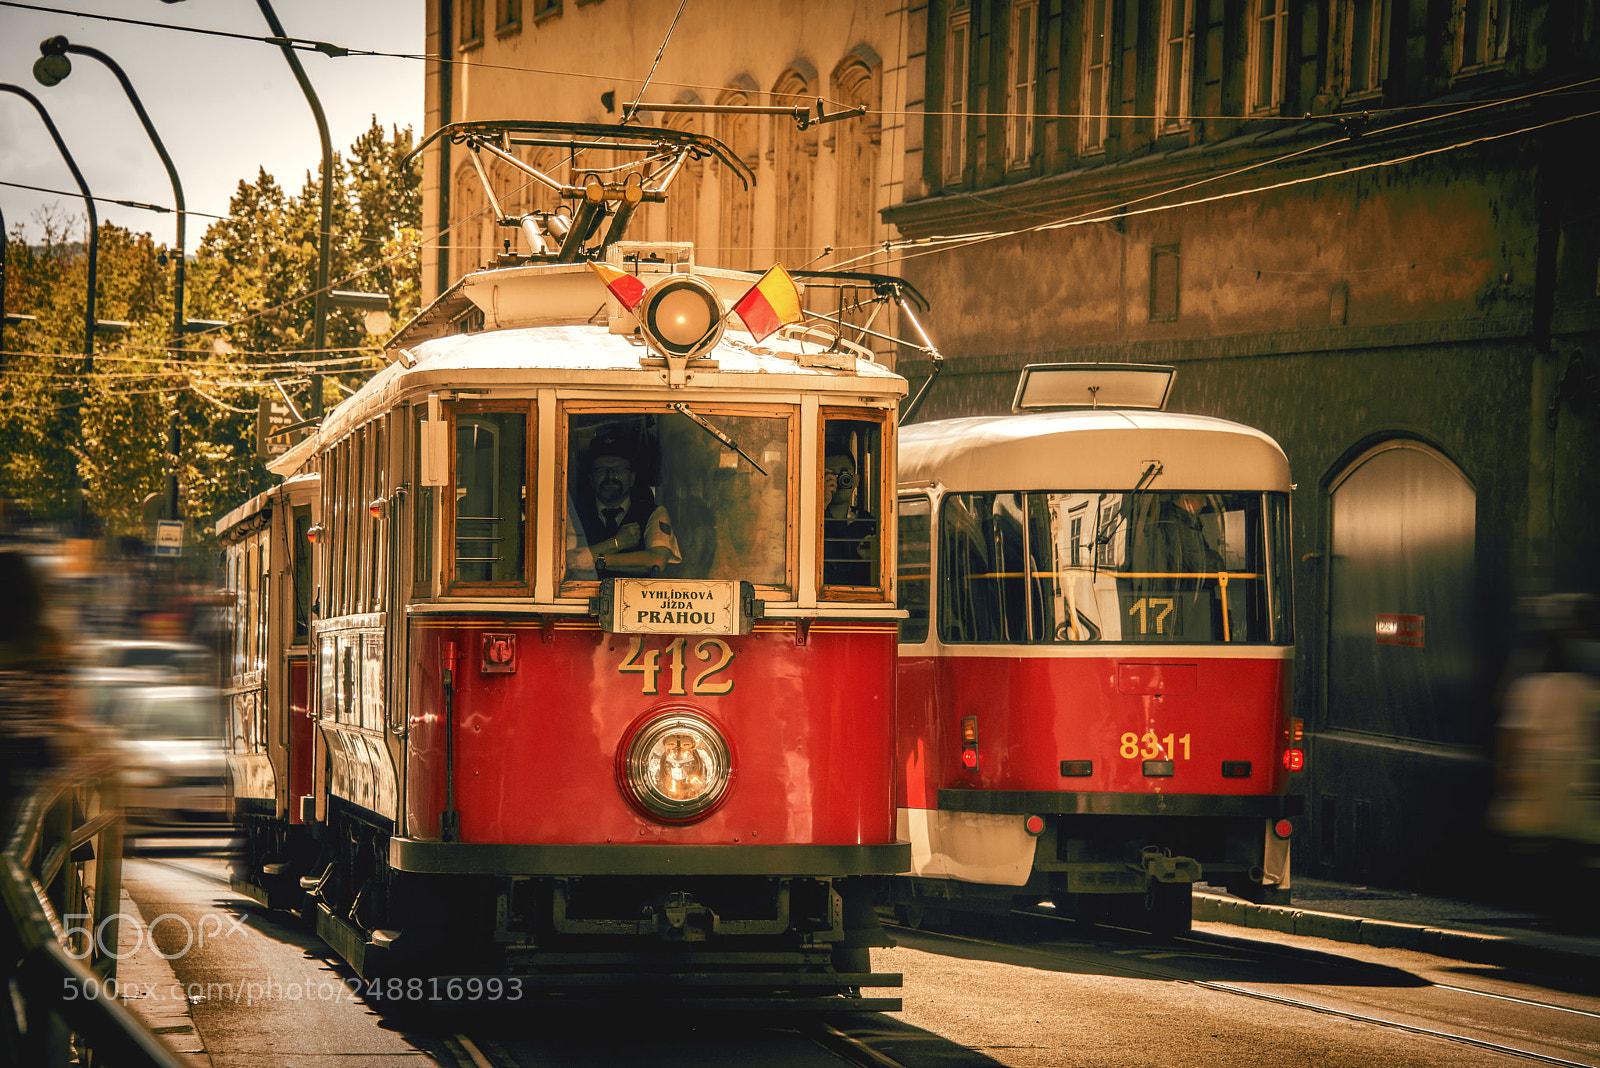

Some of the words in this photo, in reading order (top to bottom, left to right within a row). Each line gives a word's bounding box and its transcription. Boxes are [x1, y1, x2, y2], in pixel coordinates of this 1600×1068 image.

[641, 589, 714, 600] VYHLÍDKOVÁ
[660, 598, 693, 609] JÍZDA
[637, 610, 715, 625] PRAHOU
[1129, 597, 1174, 634] 17
[618, 637, 736, 696] 412
[1119, 732, 1191, 760] 8311
